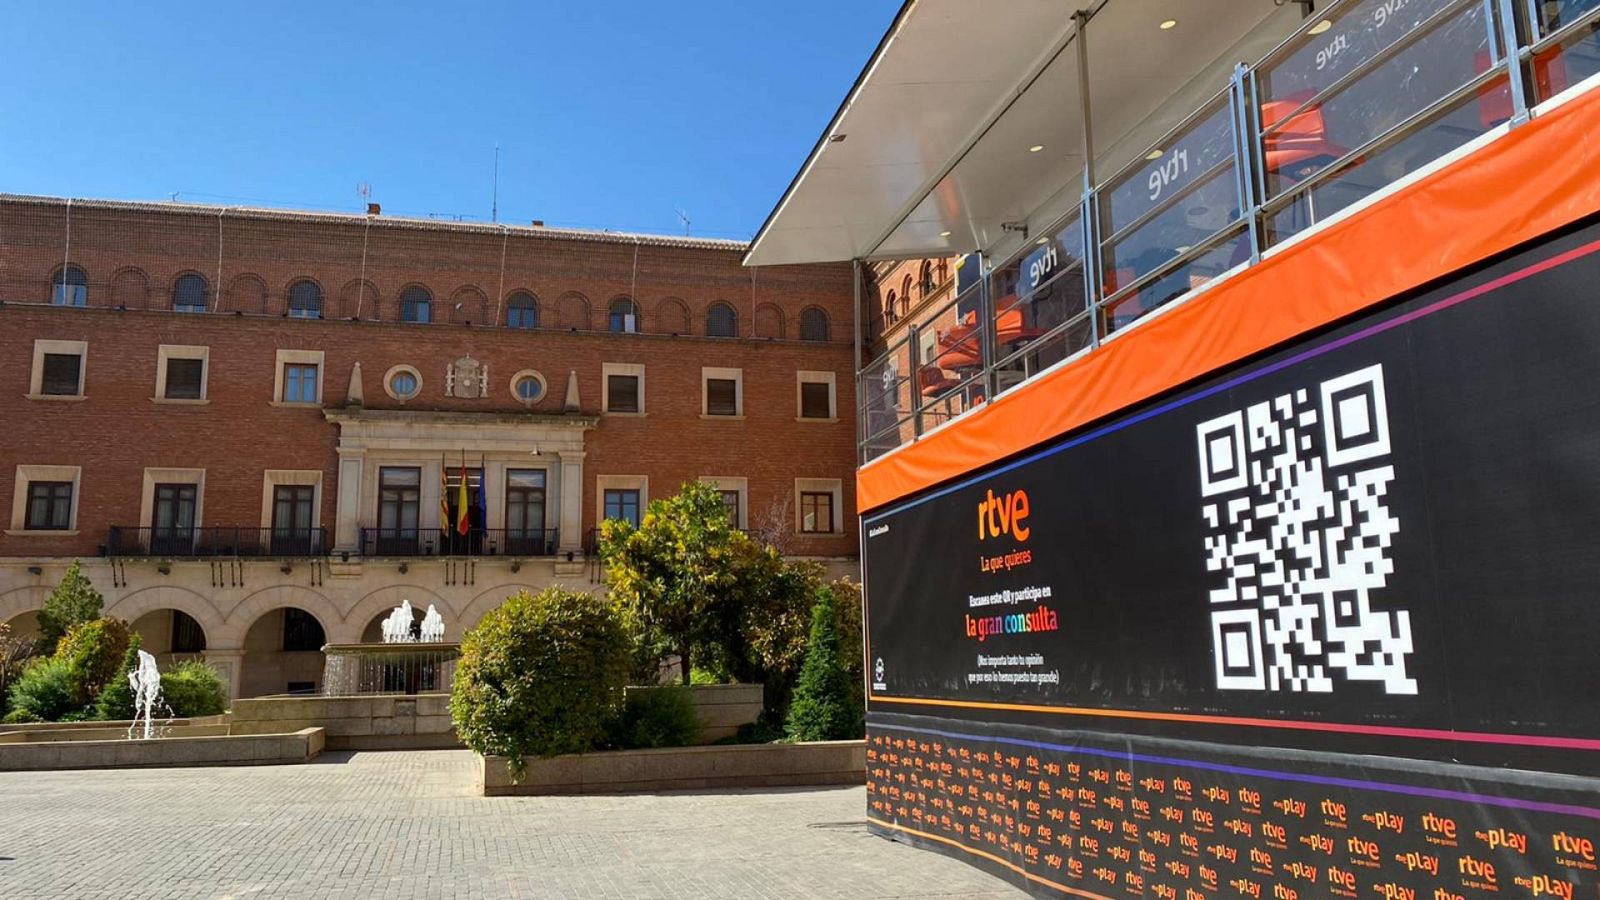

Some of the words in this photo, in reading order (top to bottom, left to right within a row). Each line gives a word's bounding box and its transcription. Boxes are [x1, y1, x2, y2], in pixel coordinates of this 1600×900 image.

[979, 489, 1030, 542] rtve
[981, 556, 990, 572] La
[990, 556, 1003, 574] que
[1004, 549, 1032, 571] quieres
[969, 595, 990, 608] Escanea
[990, 591, 1002, 604] este
[1002, 590, 1011, 603] QR
[1014, 586, 1042, 604] participa
[1042, 586, 1052, 597] en
[965, 614, 977, 637] la
[978, 616, 1003, 642] gran
[1004, 605, 1058, 633] consulta
[988, 654, 1007, 668] importa
[1007, 654, 1019, 666] tanto
[968, 673, 976, 684] que
[976, 673, 984, 684] por
[998, 671, 1014, 682] hemos
[1013, 672, 1029, 685] puesto
[1038, 669, 1060, 686] grande)
[1094, 768, 1110, 784] play
[1115, 768, 1132, 786] rtve
[1147, 778, 1165, 793] play
[1078, 786, 1096, 803] rtve
[1173, 777, 1192, 795] rtve
[1210, 787, 1230, 804] play
[1110, 796, 1124, 812] play
[1131, 797, 1149, 815] rtve
[1239, 787, 1260, 808] rtve
[1166, 806, 1183, 823] play
[1192, 807, 1213, 827] rtve
[1283, 798, 1306, 818] play
[1321, 799, 1346, 821] rtve
[1097, 818, 1114, 834] play
[1122, 819, 1138, 837] rtve
[1233, 819, 1252, 838] play
[1262, 821, 1286, 842] rtve
[1375, 811, 1404, 833] play
[1422, 812, 1457, 838] rtve
[1080, 834, 1098, 852] rtve
[1155, 830, 1171, 847] play
[1180, 832, 1198, 851] rtve
[1310, 834, 1334, 855] play
[1348, 836, 1379, 860] rtve
[1488, 828, 1526, 854] play
[1552, 831, 1595, 860] rtve
[1114, 846, 1131, 862] play
[1139, 848, 1156, 867] rtve
[1216, 844, 1237, 863] play
[1250, 847, 1273, 869] rtve
[1171, 861, 1190, 879] play
[1292, 862, 1317, 883] play
[1406, 852, 1438, 876] play
[1459, 855, 1496, 882] rtve
[1099, 867, 1116, 884] play
[1126, 870, 1143, 889] rtve
[1199, 864, 1217, 885] rtve
[1328, 866, 1356, 890] rtve
[1158, 884, 1176, 900] play
[1239, 878, 1261, 899] play
[1274, 883, 1297, 900] rtve
[1385, 883, 1415, 900] play
[1514, 876, 1532, 888] rtve
[1532, 875, 1573, 900] play
